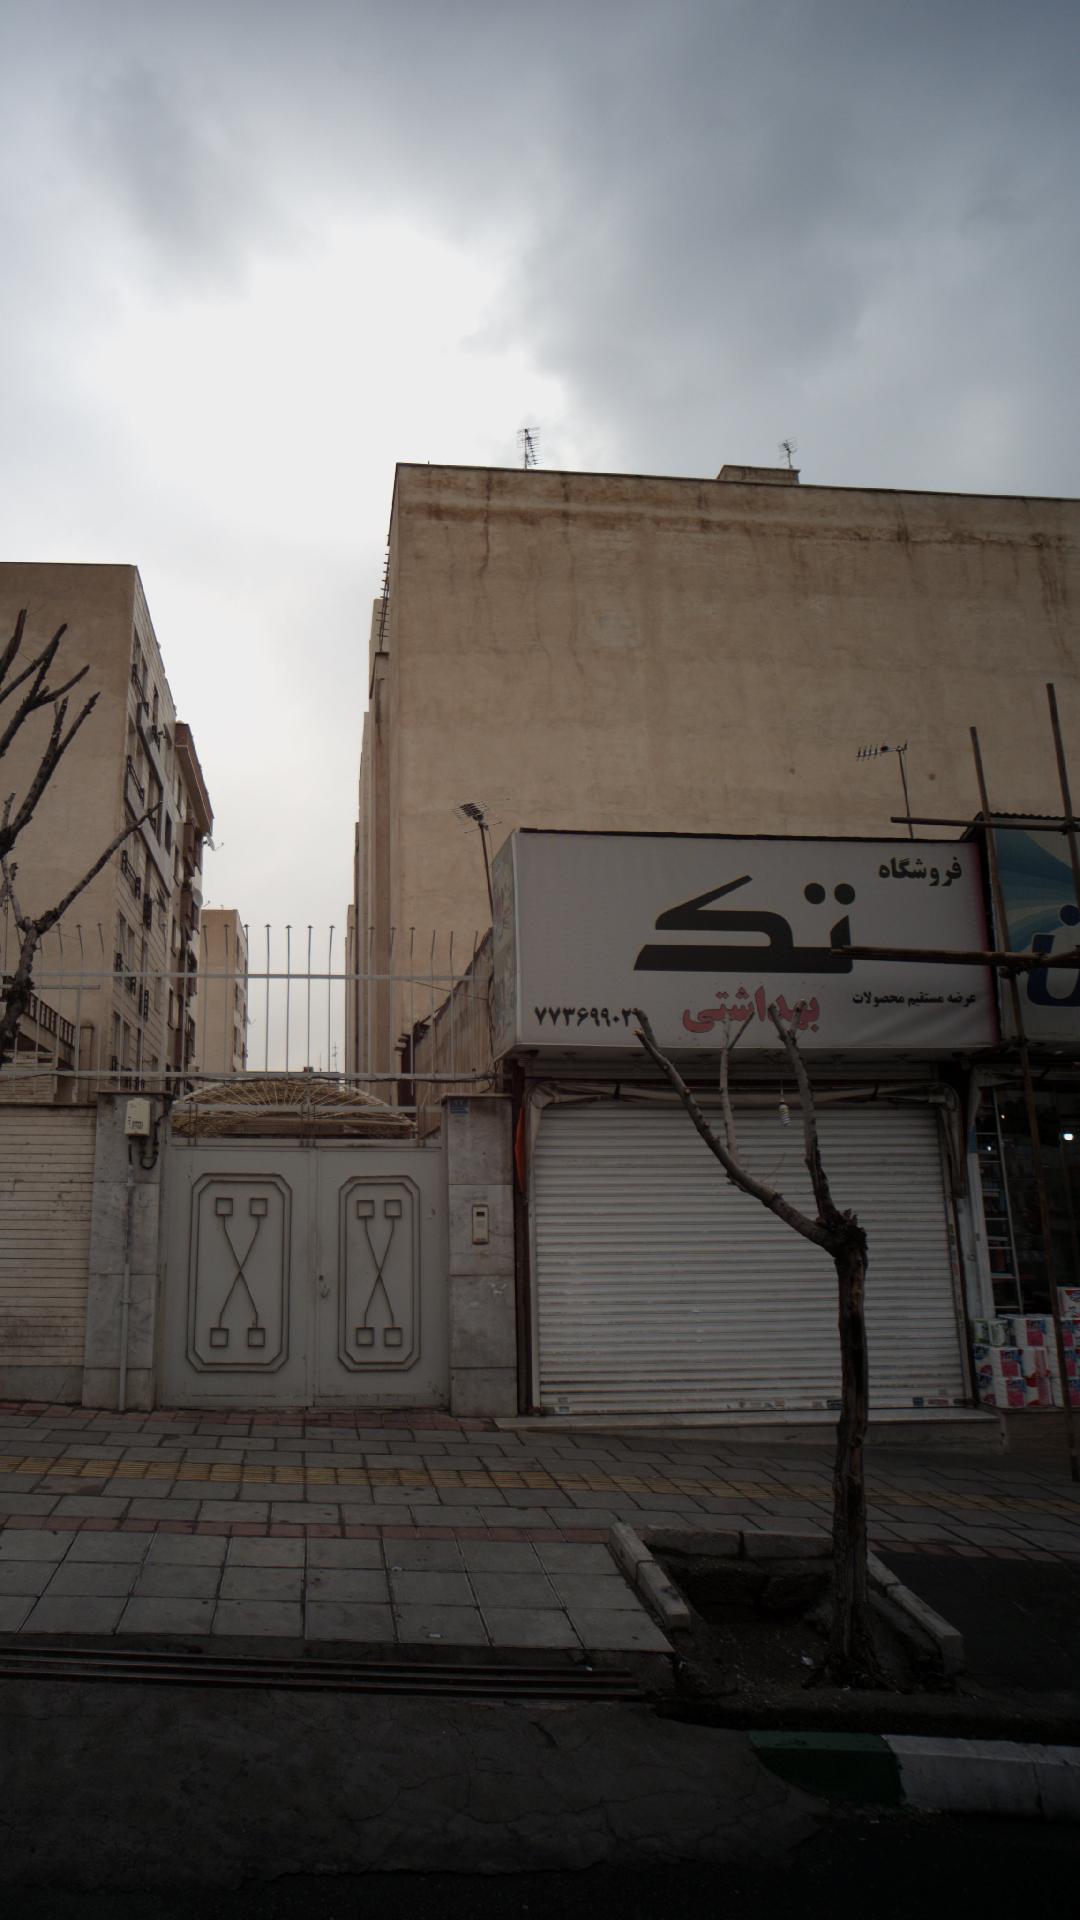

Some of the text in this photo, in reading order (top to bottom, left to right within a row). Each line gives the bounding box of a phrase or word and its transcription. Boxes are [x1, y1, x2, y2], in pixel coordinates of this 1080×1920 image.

[878, 856, 963, 887] فروشگاه
[633, 874, 856, 974] تک
[681, 985, 821, 1034] بهداشتی
[852, 991, 977, 1008] عرضه مستقیم محصولات
